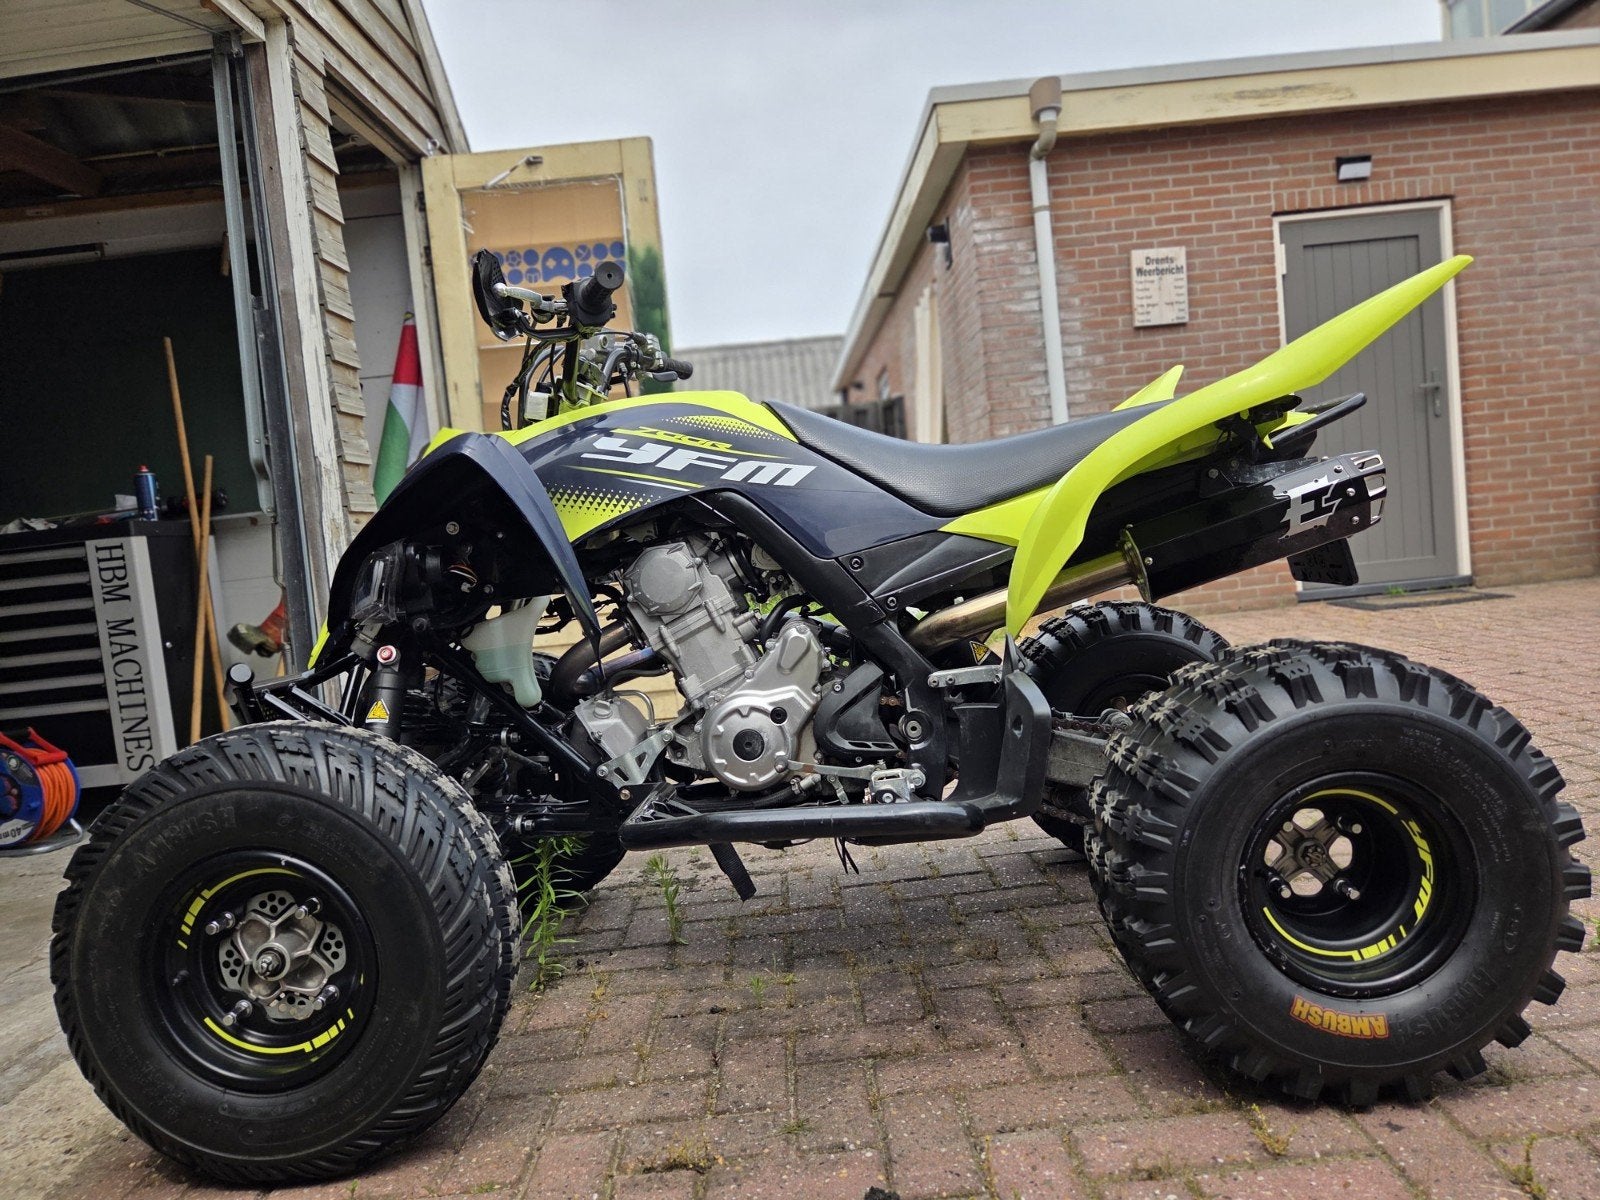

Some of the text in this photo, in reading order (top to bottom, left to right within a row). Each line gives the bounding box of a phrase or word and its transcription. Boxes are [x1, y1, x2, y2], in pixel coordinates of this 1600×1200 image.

[1135, 264, 1184, 277] Weerbericht
[1145, 256, 1174, 265] Drents
[580, 436, 818, 487] YFM
[95, 542, 156, 772] HBM MACHINES
[1291, 995, 1389, 1038] AMBUSH
